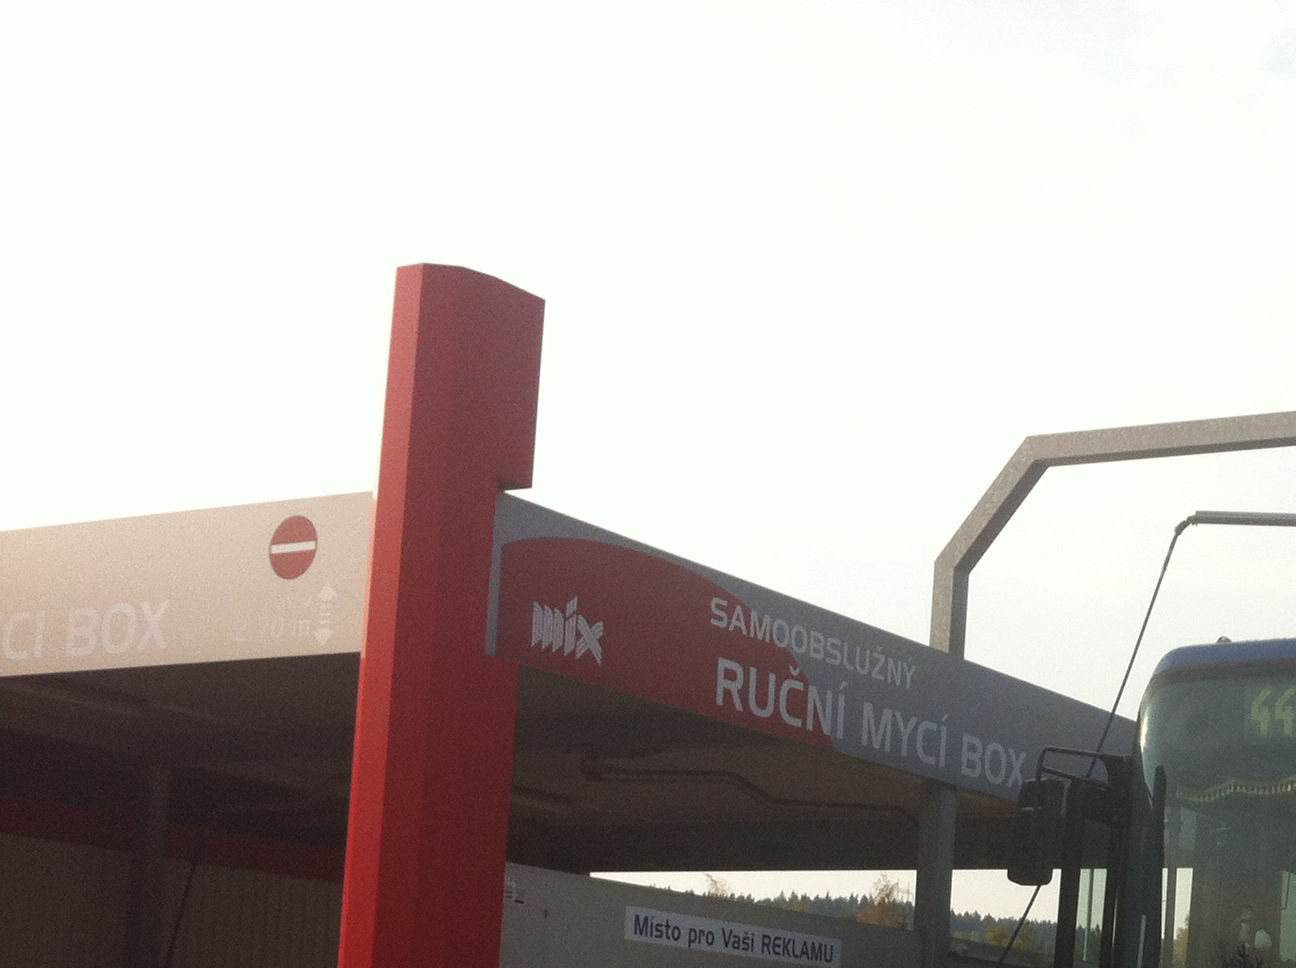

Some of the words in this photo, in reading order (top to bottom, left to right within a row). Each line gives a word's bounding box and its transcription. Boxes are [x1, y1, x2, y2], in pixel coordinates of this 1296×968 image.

[65, 599, 170, 658] BOX
[710, 596, 917, 690] SAMOOBSLUŽNÝ
[715, 656, 846, 740] RUČNÍ
[860, 700, 950, 769] MYCÍ
[960, 735, 1027, 787] BOX
[634, 913, 682, 941] Místo
[687, 924, 715, 949] pro
[721, 926, 755, 953] Vaši
[761, 933, 834, 964] REKLAMU
